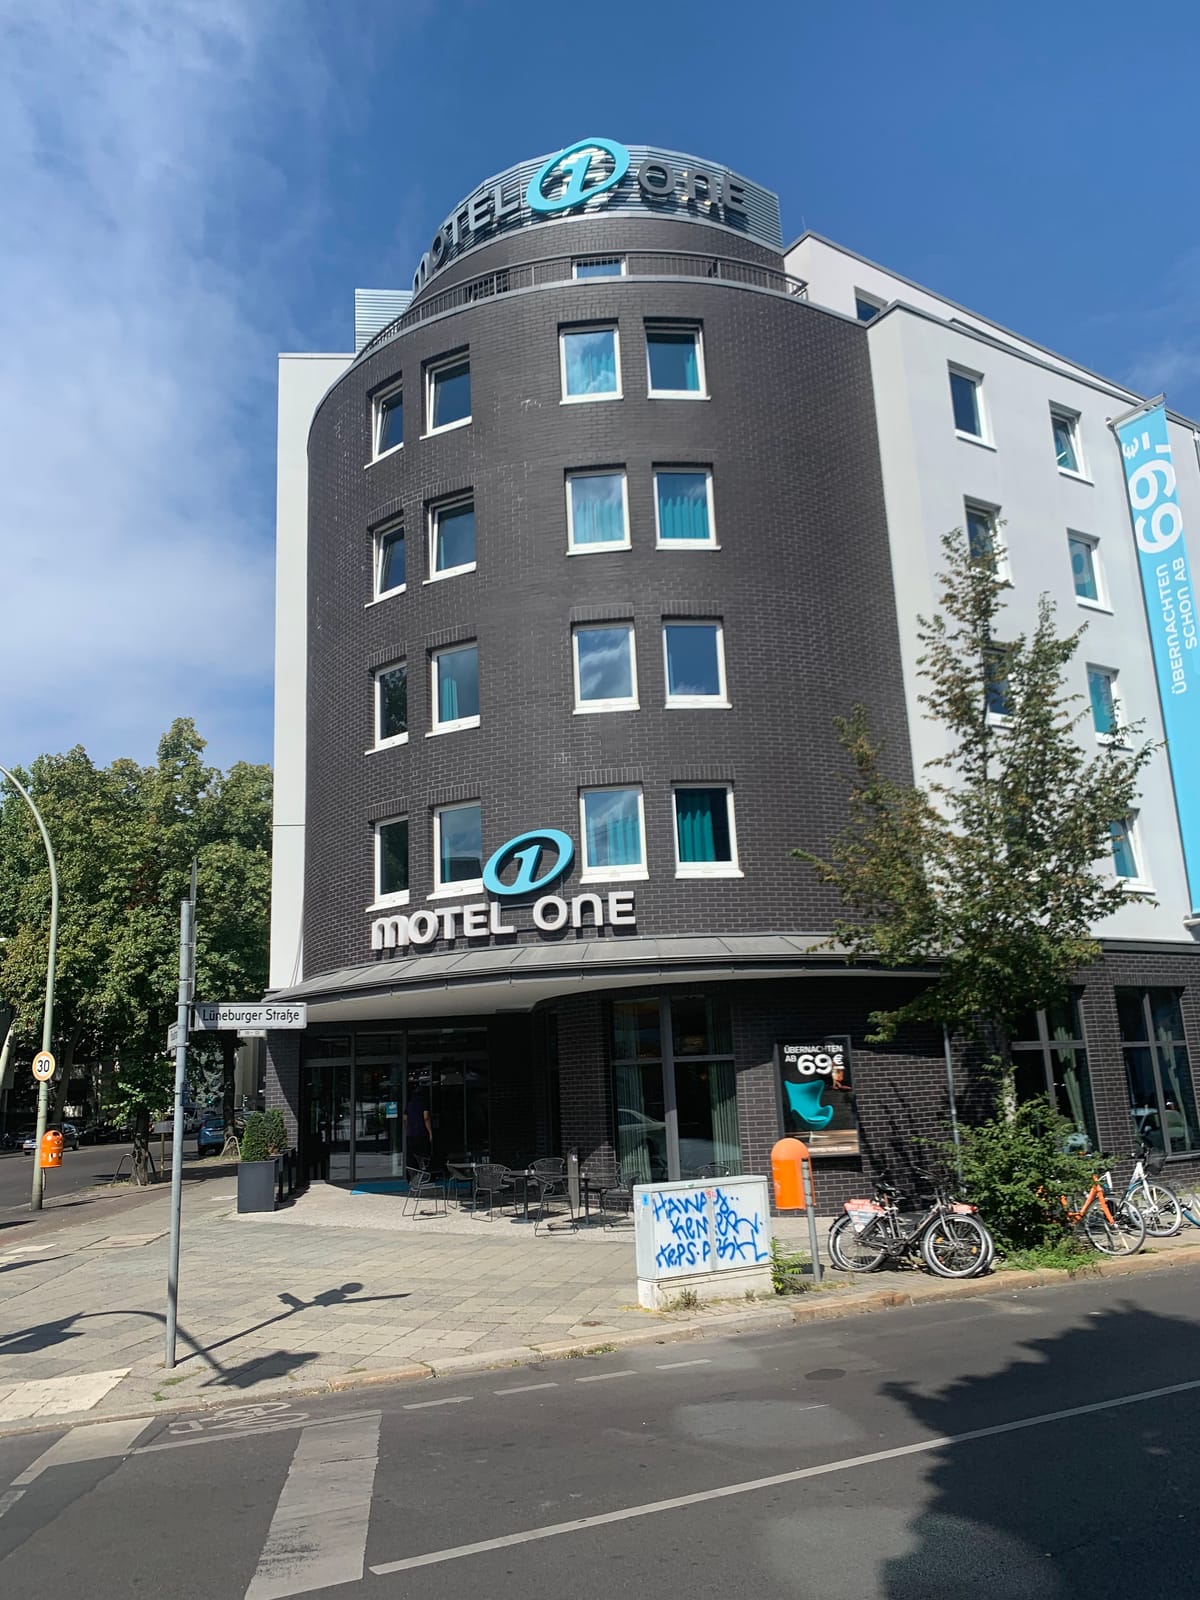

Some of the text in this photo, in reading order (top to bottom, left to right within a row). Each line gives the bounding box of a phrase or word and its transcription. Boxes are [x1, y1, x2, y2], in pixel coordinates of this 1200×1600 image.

[1172, 557, 1187, 582] AB
[371, 890, 637, 950] MOTEL ONE
[202, 1008, 300, 1024] Lüneburger Straße
[36, 1059, 50, 1073] 30
